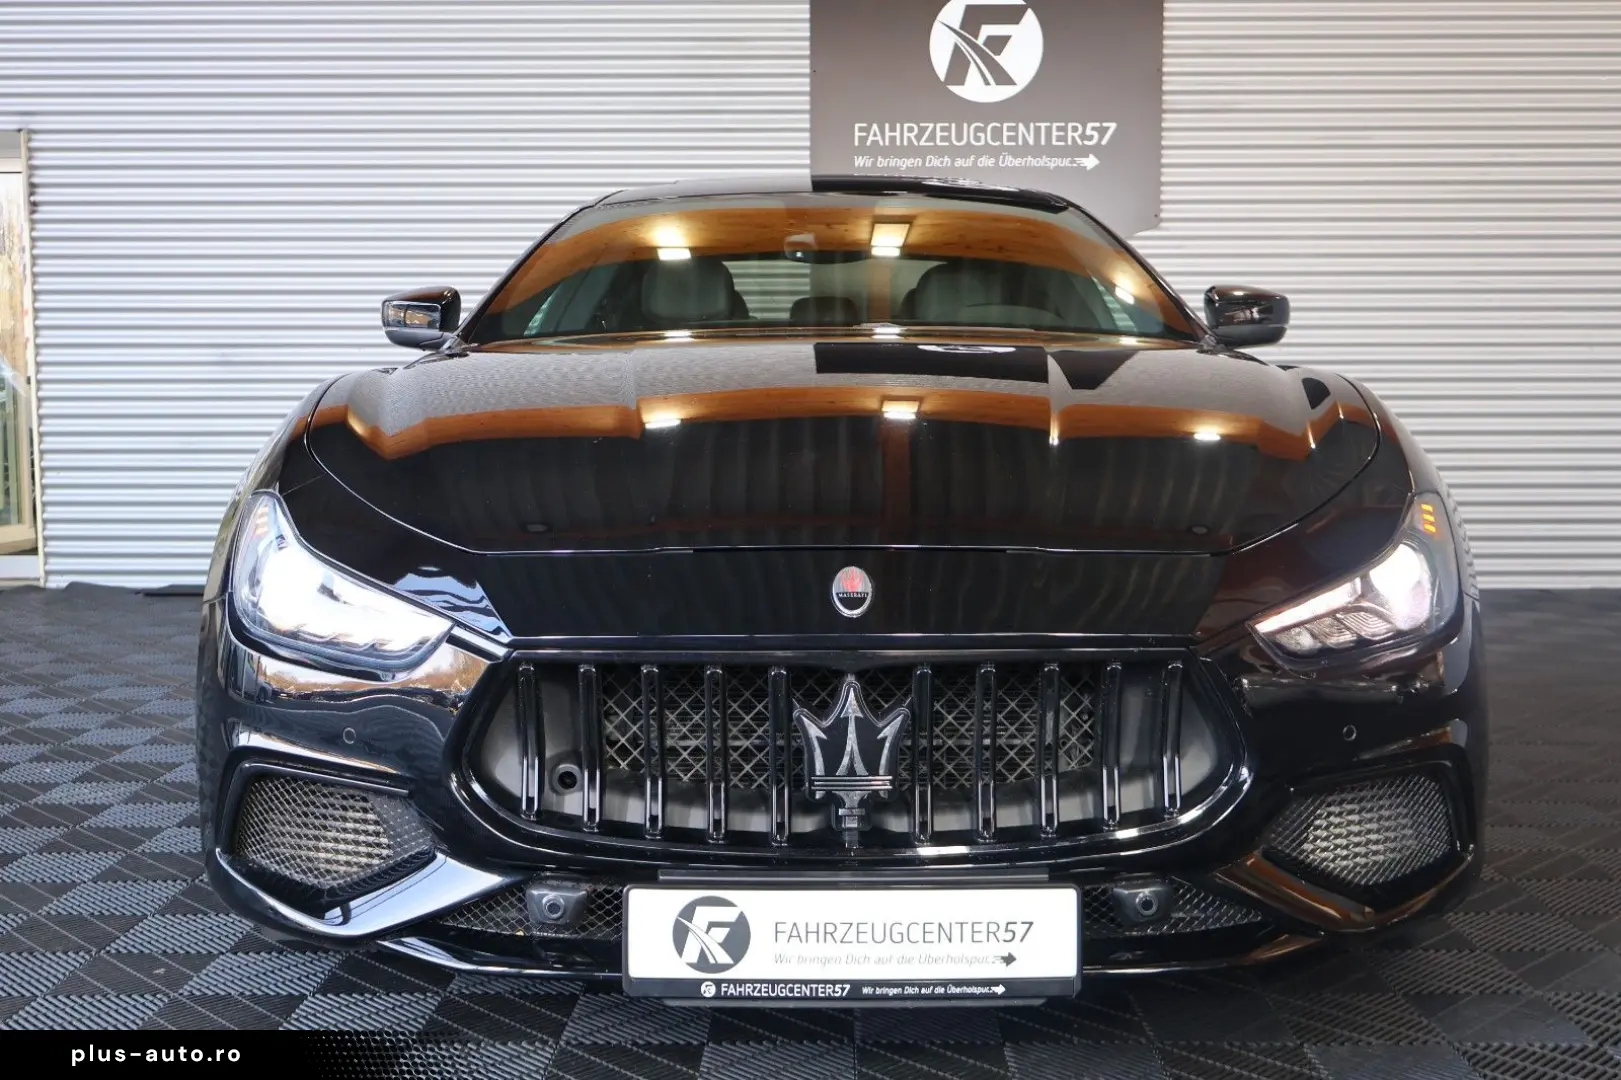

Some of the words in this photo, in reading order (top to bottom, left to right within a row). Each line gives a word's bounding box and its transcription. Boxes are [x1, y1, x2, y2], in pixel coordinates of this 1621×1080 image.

[853, 122, 1117, 147] FAHRZEUGCENTER57
[853, 155, 874, 168] Wir
[876, 155, 922, 170] bringen
[925, 155, 951, 167] Dich
[954, 155, 975, 167] auf
[977, 155, 996, 167] die
[774, 921, 1034, 944] FAHRZEUGCENTER57
[774, 953, 792, 964] Wir
[796, 953, 842, 968] bringen
[845, 953, 870, 965] Dich
[873, 953, 893, 965] auf
[897, 953, 915, 964] die
[720, 983, 851, 997] FAHRZEUGCENTER57
[862, 986, 874, 994] Wir
[875, 986, 902, 996] bringen
[903, 985, 919, 994] Dich
[920, 985, 933, 994] auf
[933, 985, 945, 994] die
